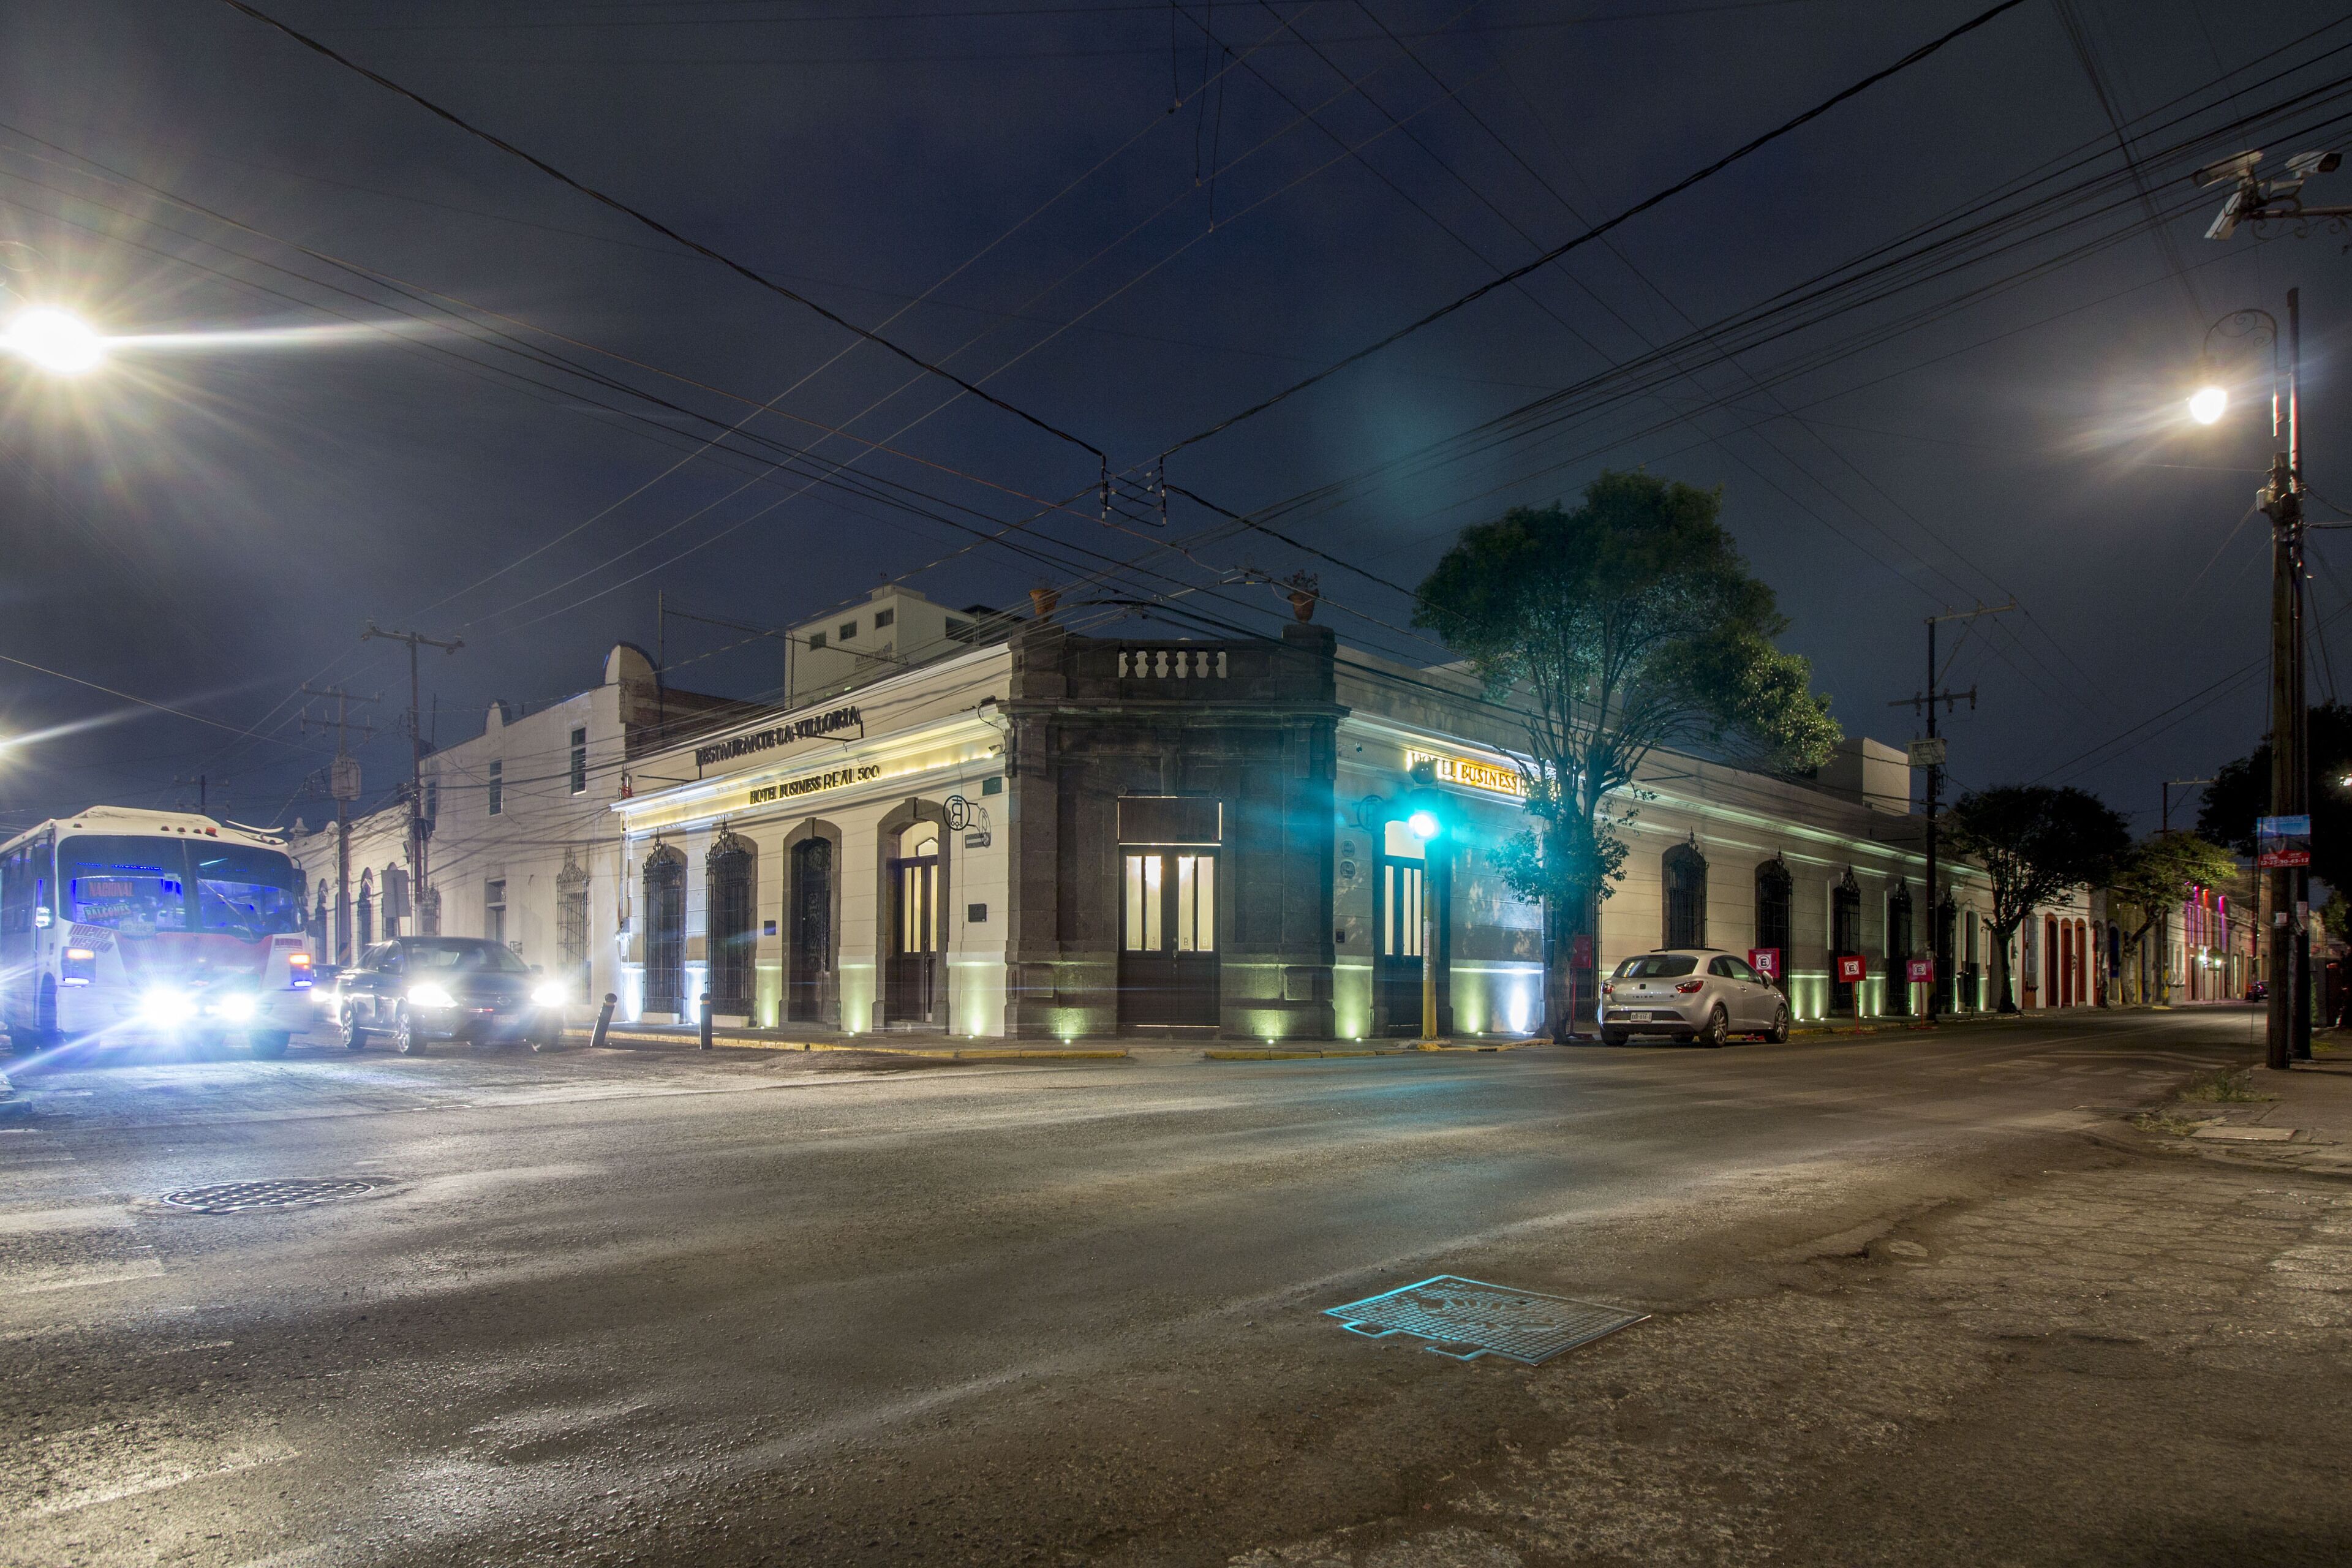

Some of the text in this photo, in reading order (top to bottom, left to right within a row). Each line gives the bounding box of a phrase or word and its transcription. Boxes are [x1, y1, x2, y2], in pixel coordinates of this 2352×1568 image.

[695, 706, 861, 766] RESTAURANTE LA VILLORIA
[750, 764, 881, 804] HOTEL BUSINESS REAL 500
[1461, 764, 1517, 790] BUSINESS
[89, 881, 135, 897] NACIONAL
[85, 903, 132, 919] BALCONES
